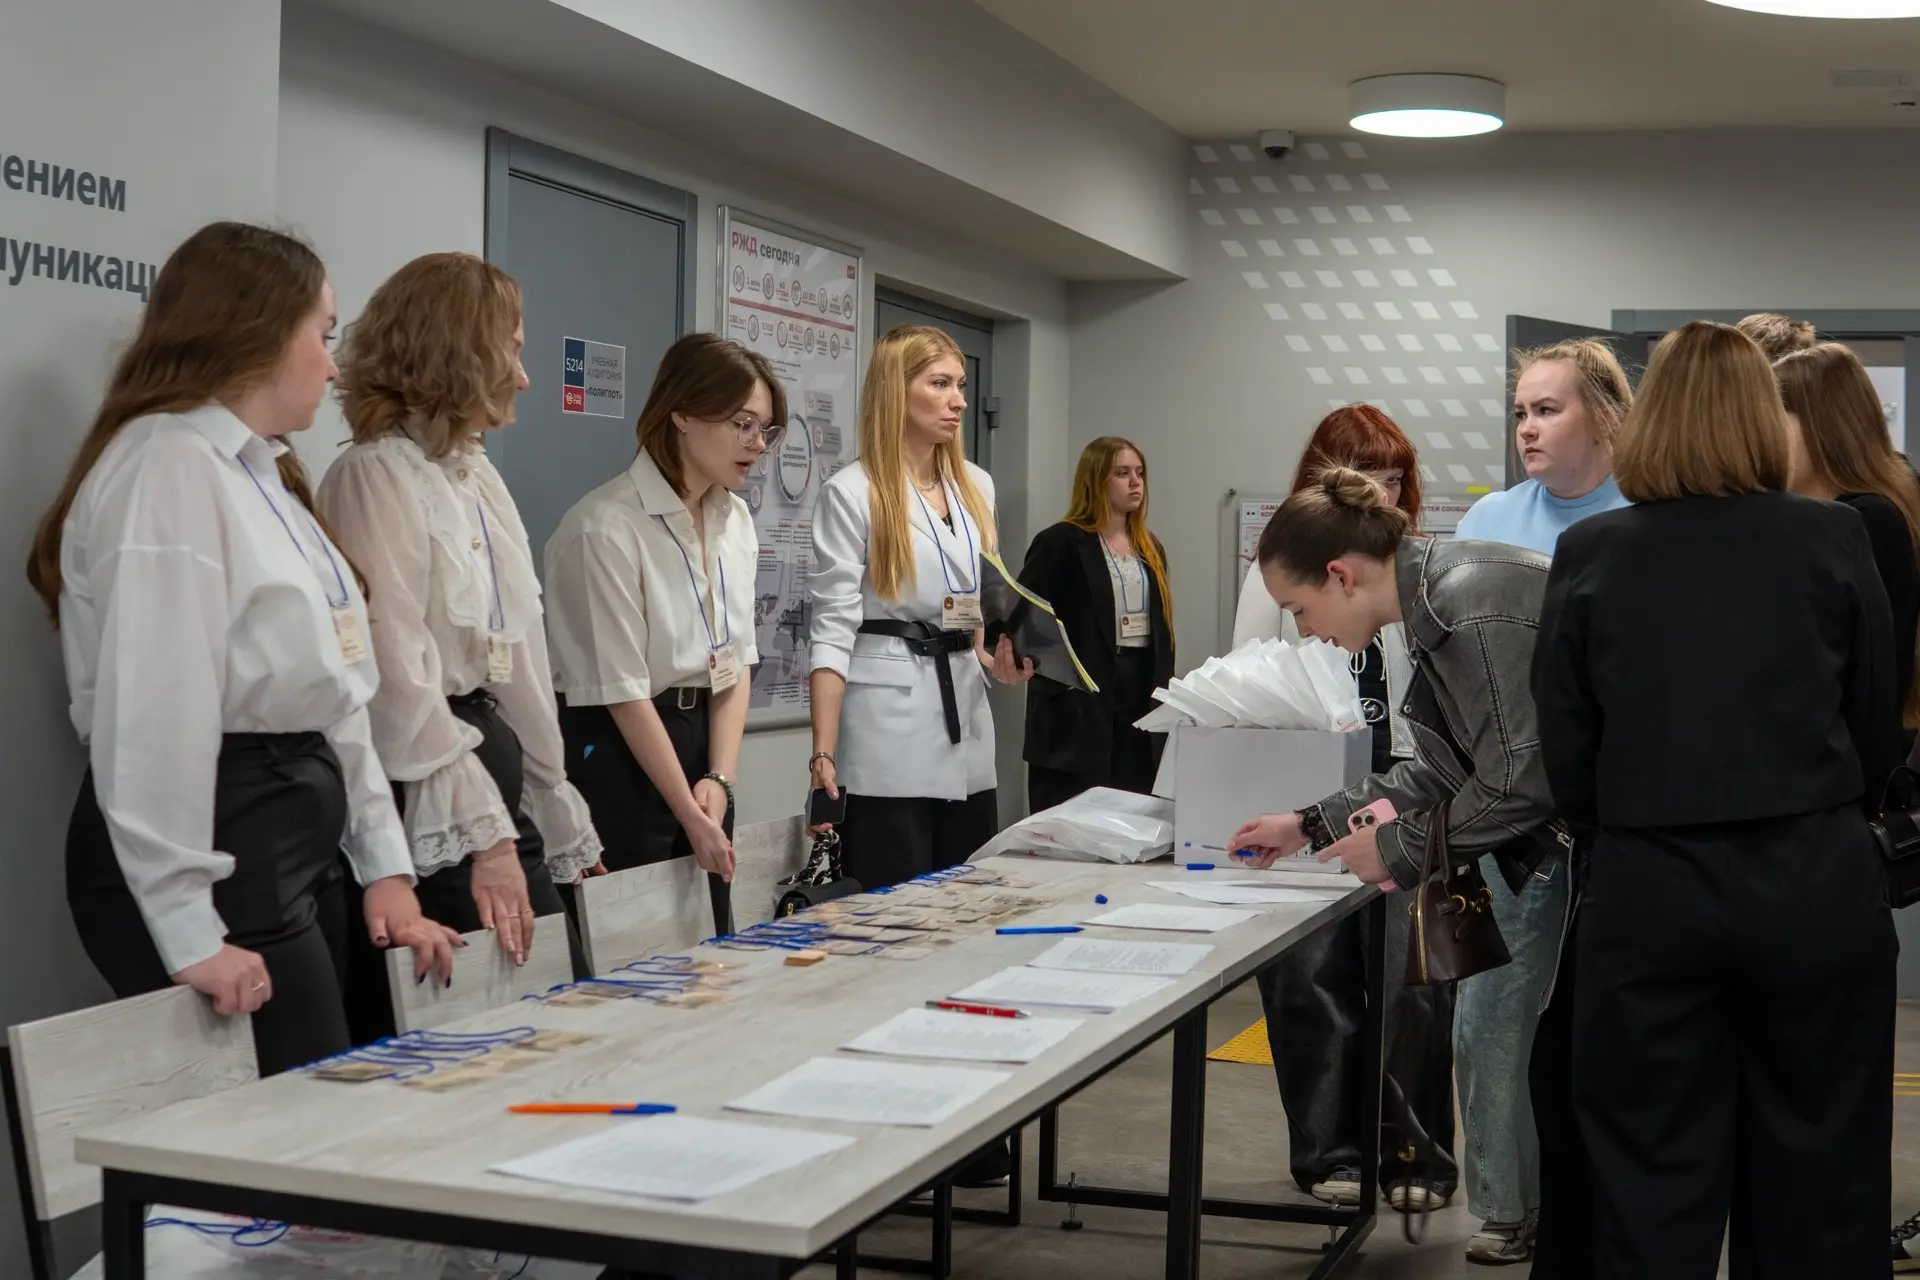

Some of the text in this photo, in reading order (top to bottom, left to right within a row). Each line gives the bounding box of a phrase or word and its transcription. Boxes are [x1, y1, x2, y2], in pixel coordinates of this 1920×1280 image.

[0, 153, 126, 212] ением
[732, 231, 800, 266] РЖД сегодня
[565, 357, 584, 373] 5214
[591, 356, 618, 368] УЧЕБНАЯ
[586, 368, 622, 381] АУДИТОРИЯ
